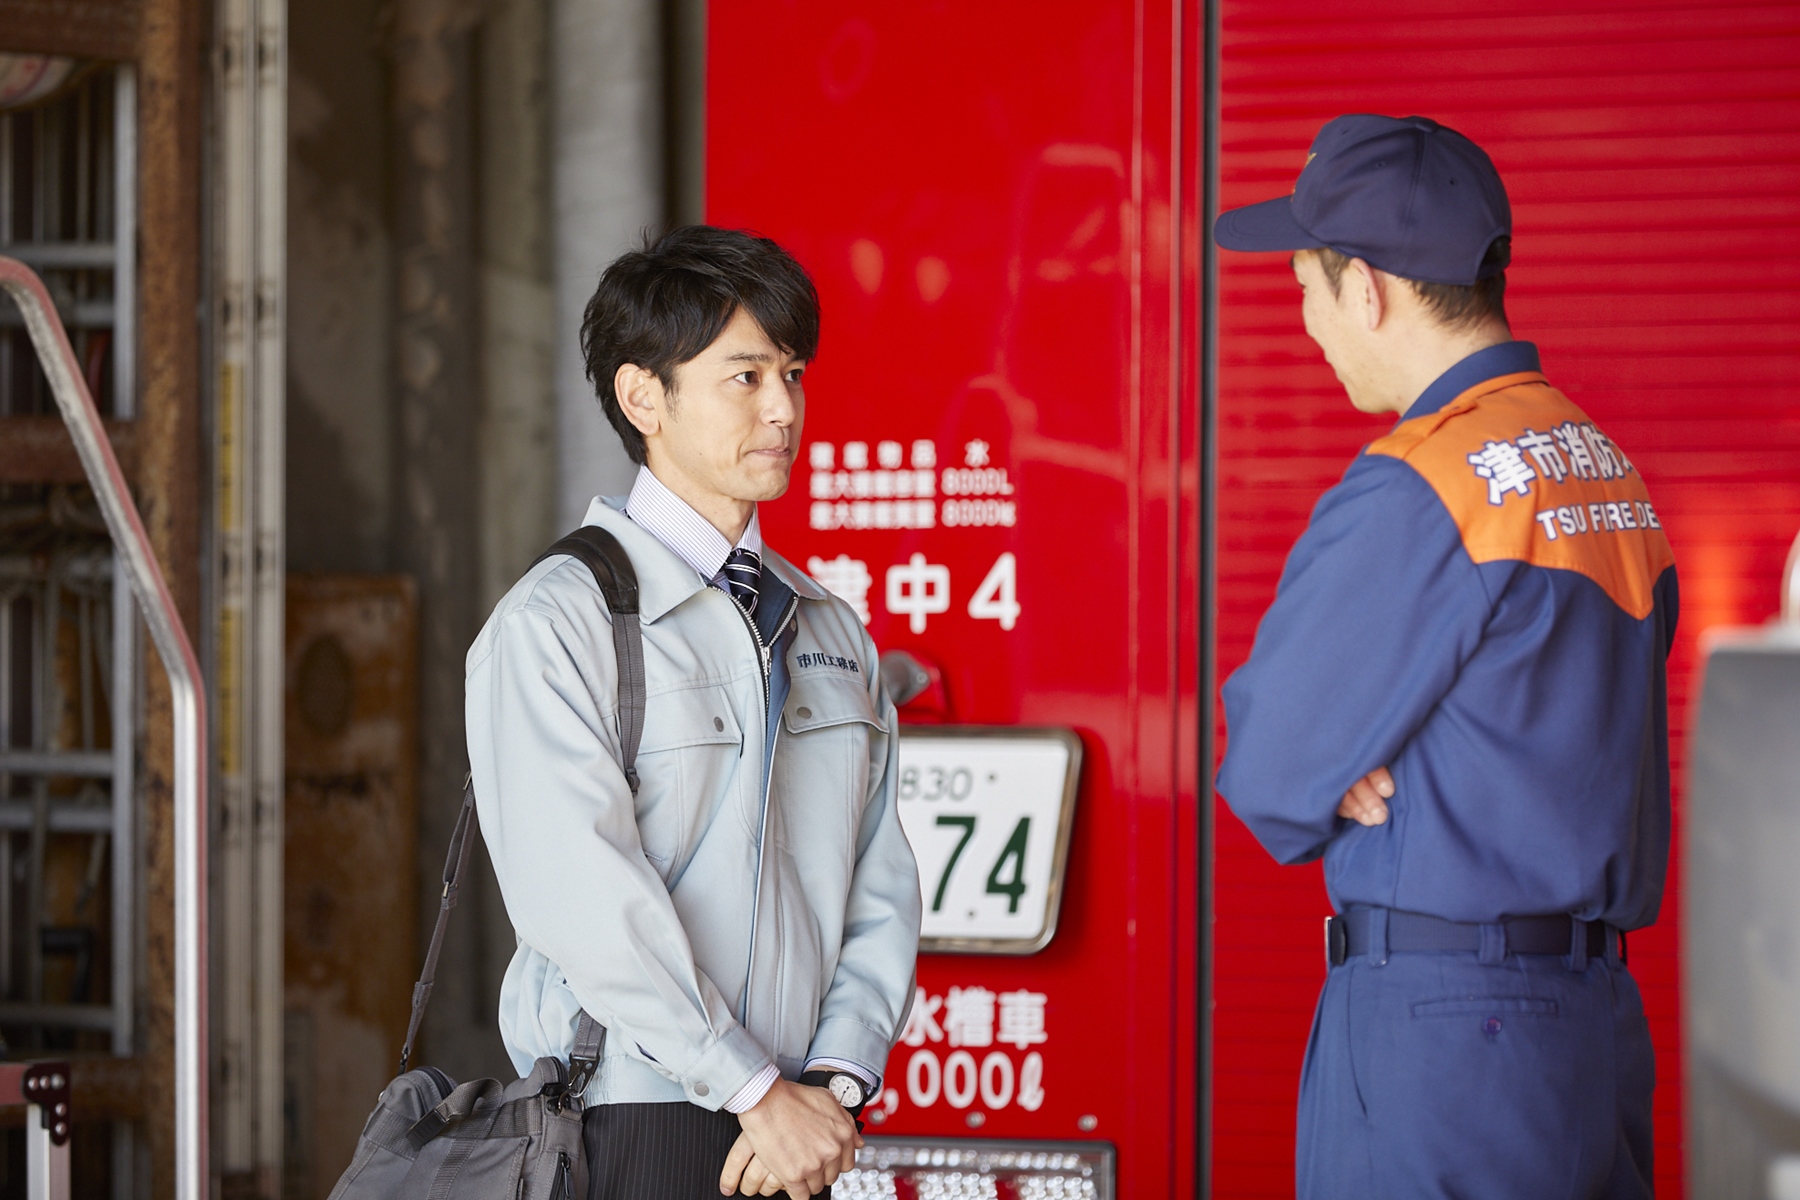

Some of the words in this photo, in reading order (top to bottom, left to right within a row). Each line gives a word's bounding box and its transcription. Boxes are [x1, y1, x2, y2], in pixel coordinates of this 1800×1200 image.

[1467, 420, 1633, 505] 津市消防
[1536, 504, 1588, 541] TSU
[1588, 500, 1637, 533] FIRE
[796, 652, 859, 673] 市川工務店
[899, 765, 974, 802] 830
[931, 816, 1031, 914] 74
